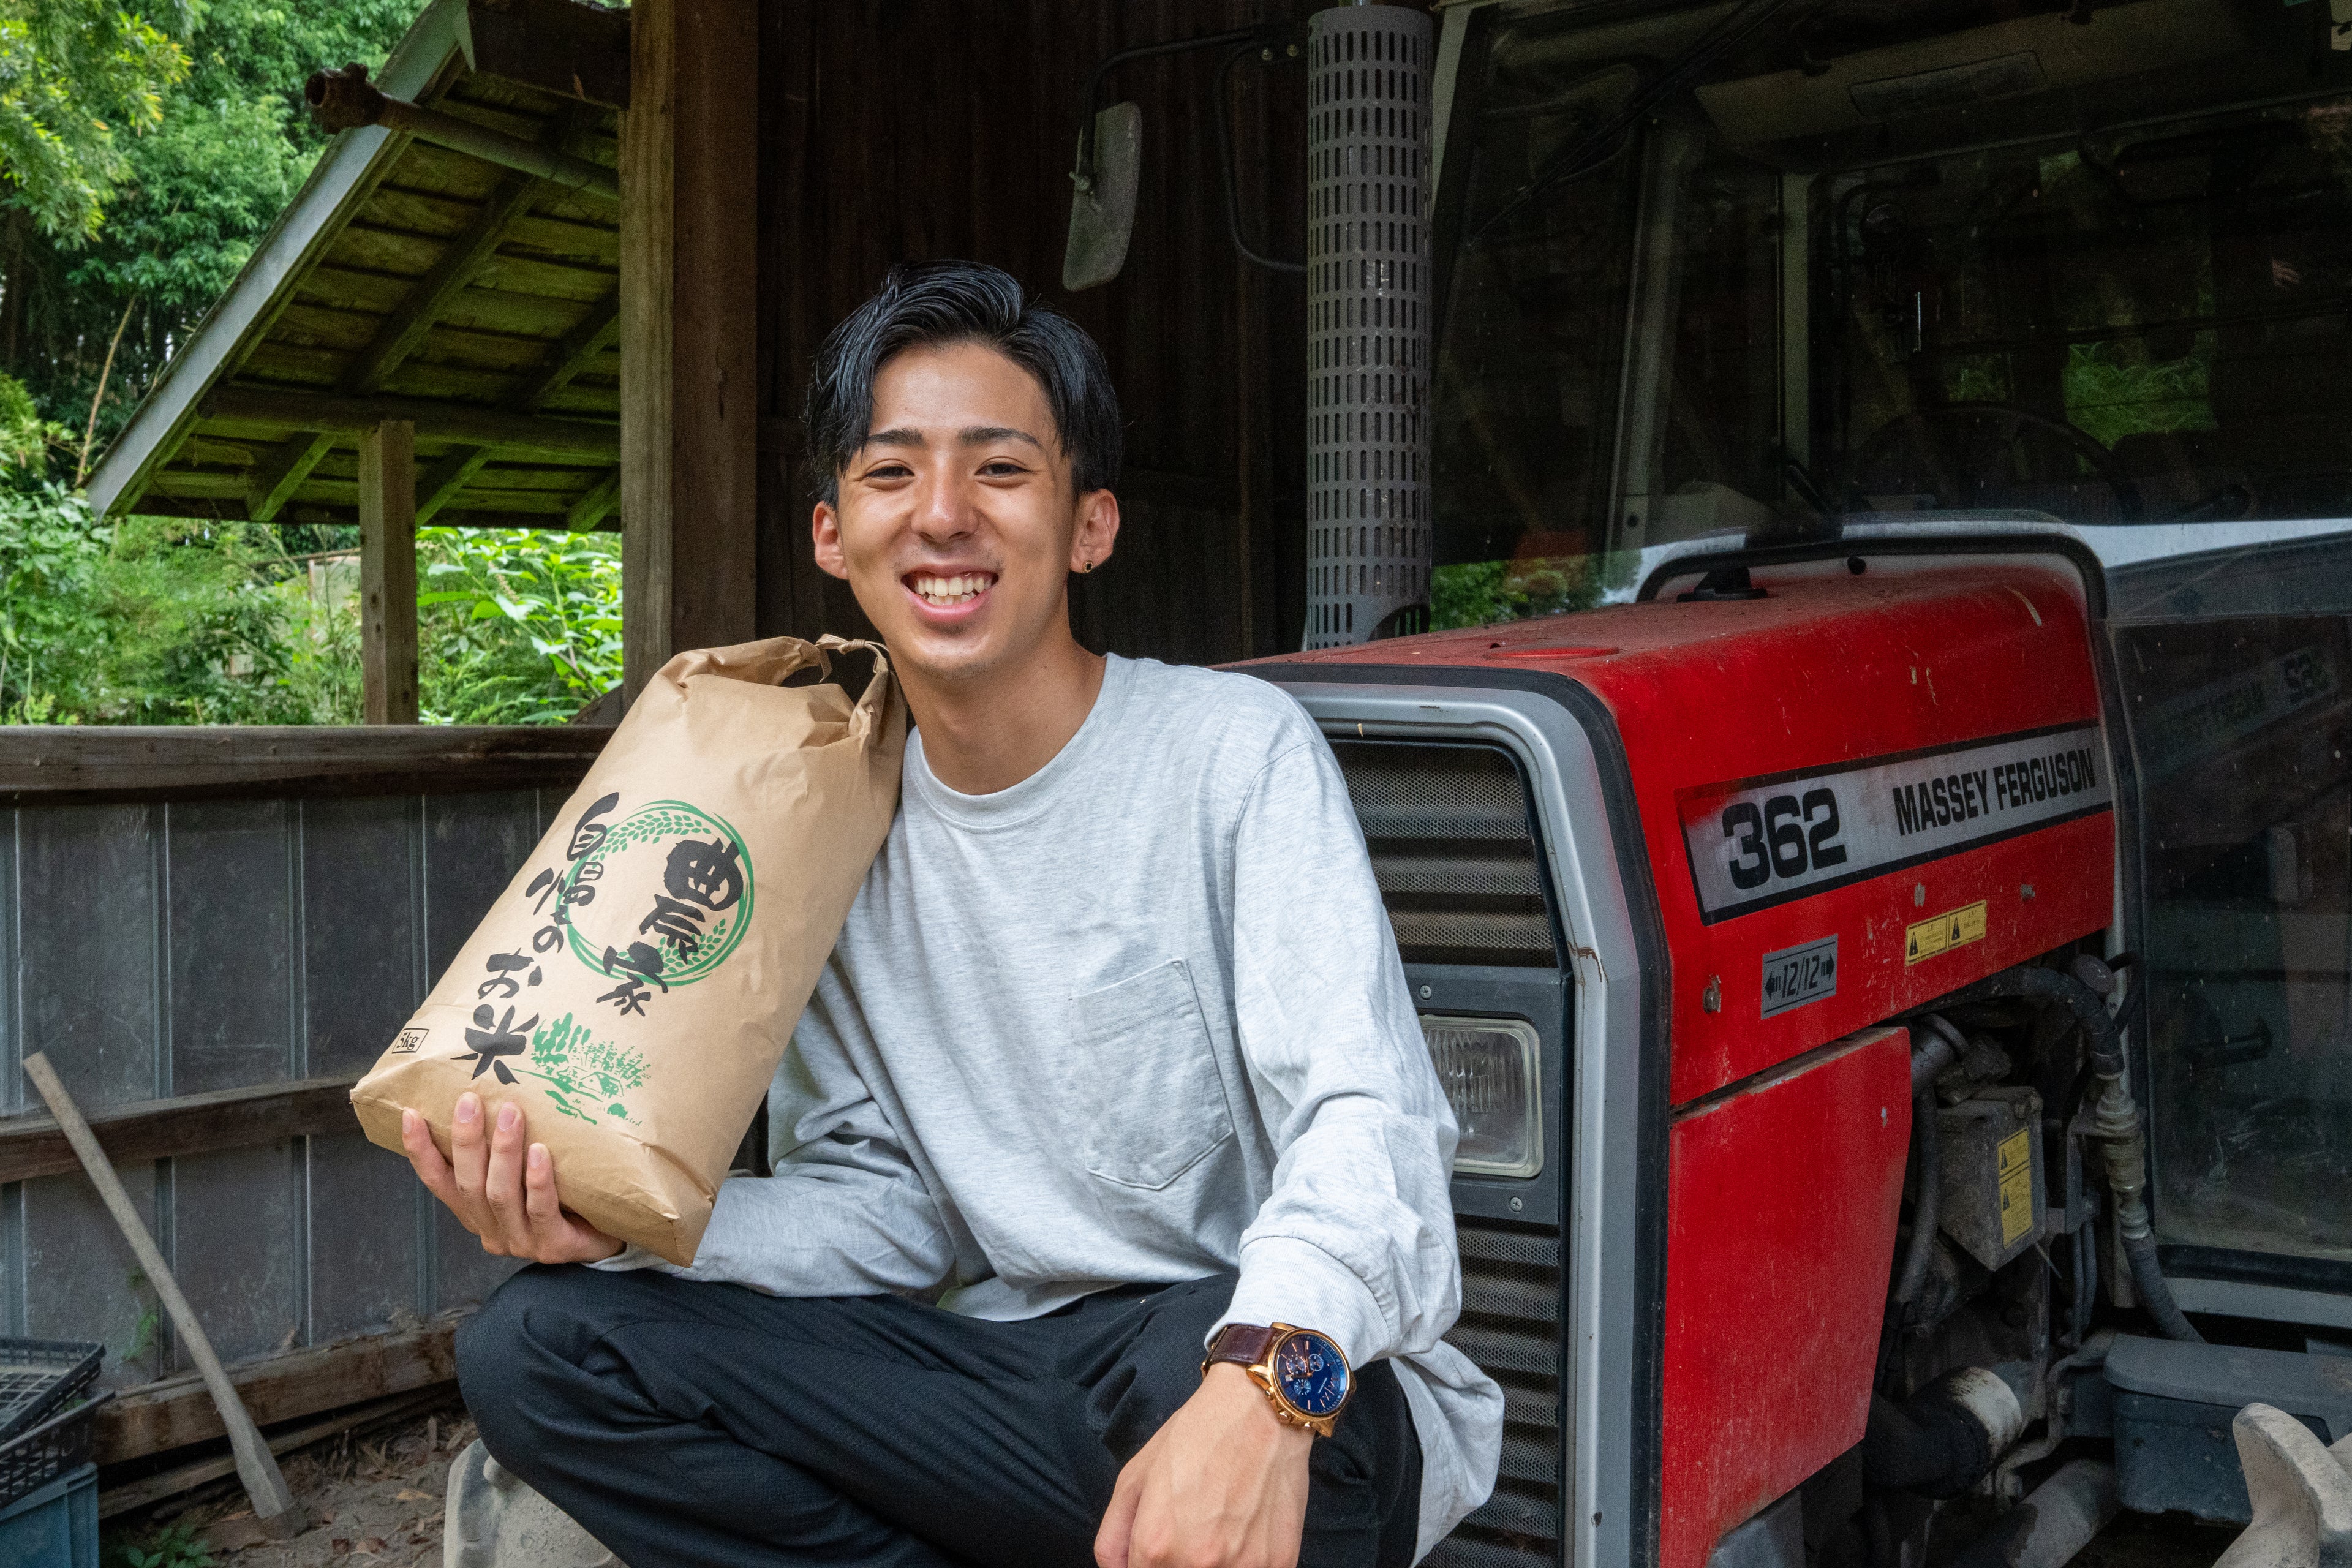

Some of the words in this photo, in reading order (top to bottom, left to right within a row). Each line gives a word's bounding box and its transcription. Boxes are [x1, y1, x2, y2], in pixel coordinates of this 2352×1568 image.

[1722, 788, 1847, 891] 362
[1892, 769, 1989, 836] MASSEY
[1993, 748, 2095, 811] FERGUSON
[450, 792, 619, 1085] 自慢のお米
[596, 838, 744, 1017] 農家
[1781, 955, 1820, 998] 12/12
[396, 1032, 420, 1050] 5kg
